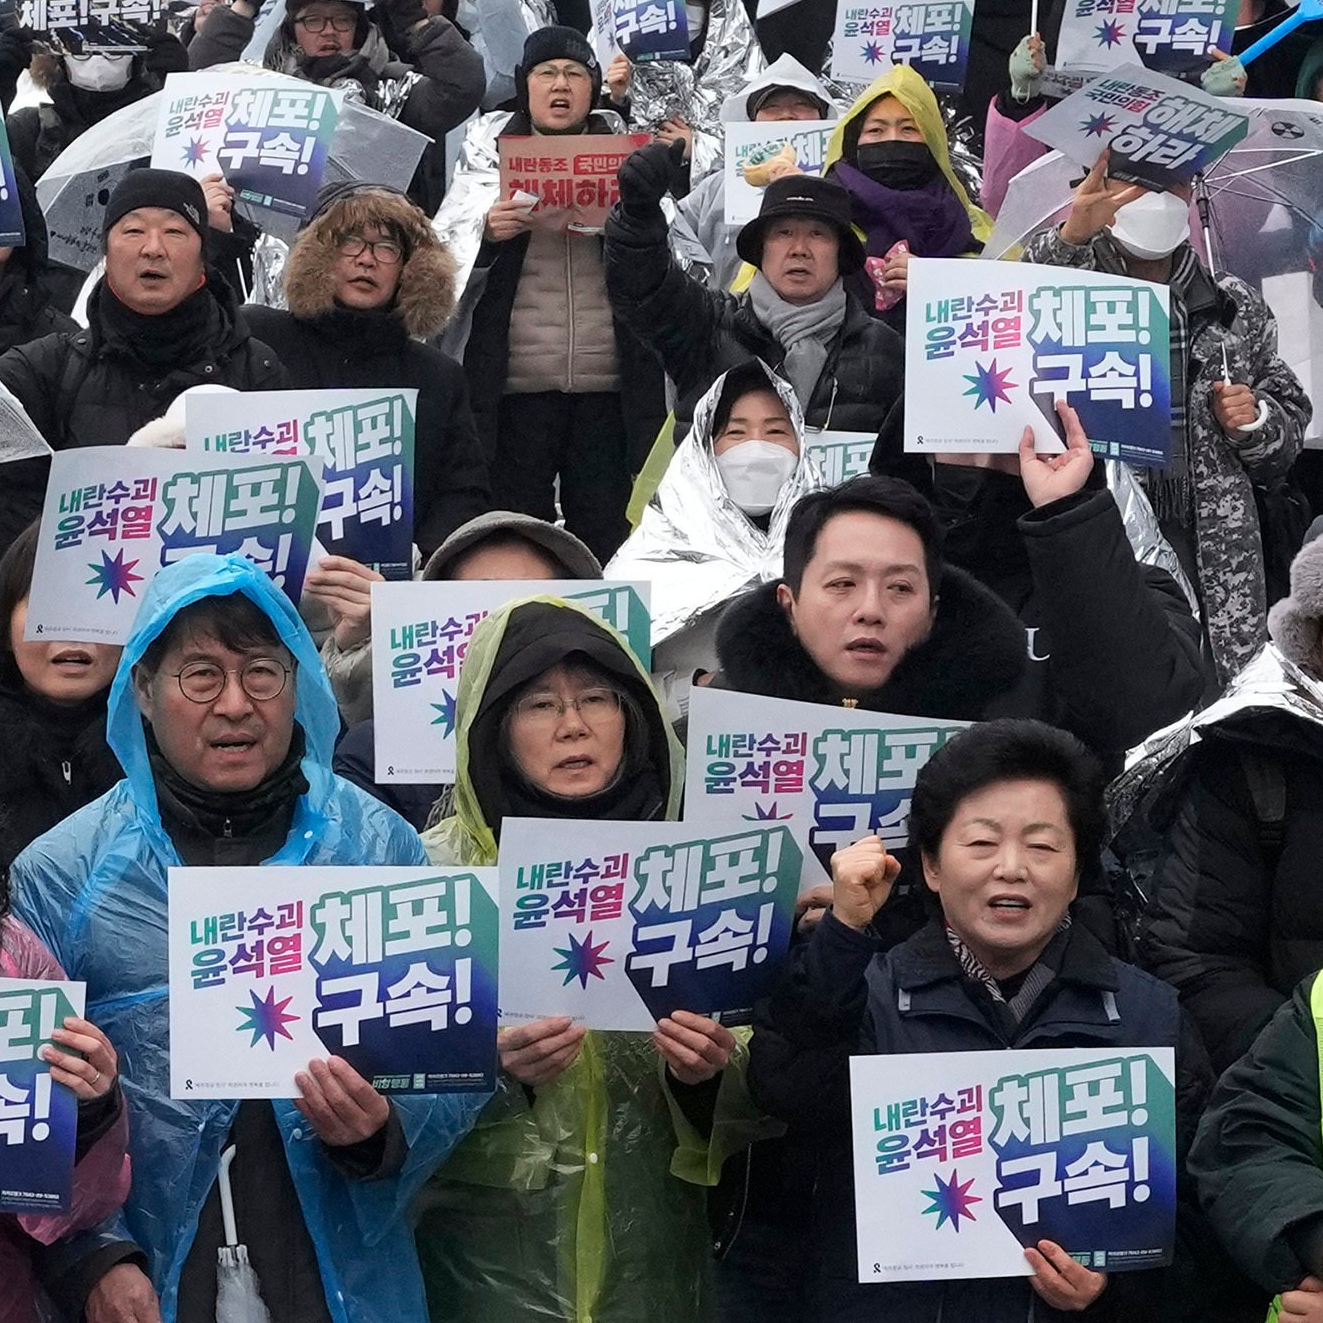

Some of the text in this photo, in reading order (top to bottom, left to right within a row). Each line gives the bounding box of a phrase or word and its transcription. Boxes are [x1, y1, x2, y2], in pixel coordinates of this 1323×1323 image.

[892, 1, 963, 37] 체포!
[892, 30, 959, 66] 구속!
[224, 86, 329, 132] 체포!
[509, 155, 623, 174] 내란동조 국민의
[924, 289, 1024, 326] 내란수괴
[1027, 285, 1152, 347] 체포!
[924, 318, 1023, 361] 윤석열
[1029, 352, 1153, 410] 구속!
[303, 397, 402, 471] 체포!
[57, 476, 158, 516] 내란수괴
[162, 464, 300, 538] 체포!
[390, 608, 489, 651] 내란수괴
[704, 732, 808, 760] 내란수괴
[704, 760, 806, 796] 윤석열
[633, 828, 778, 914] 체포!
[189, 901, 304, 946] 내란수괴
[629, 903, 770, 988] 구속!
[189, 931, 302, 990] 윤석열
[873, 1084, 985, 1132] 내란수괴
[990, 1057, 1149, 1147] 체포!
[874, 1117, 985, 1174] 윤석열
[997, 1136, 1152, 1226] 구속!
